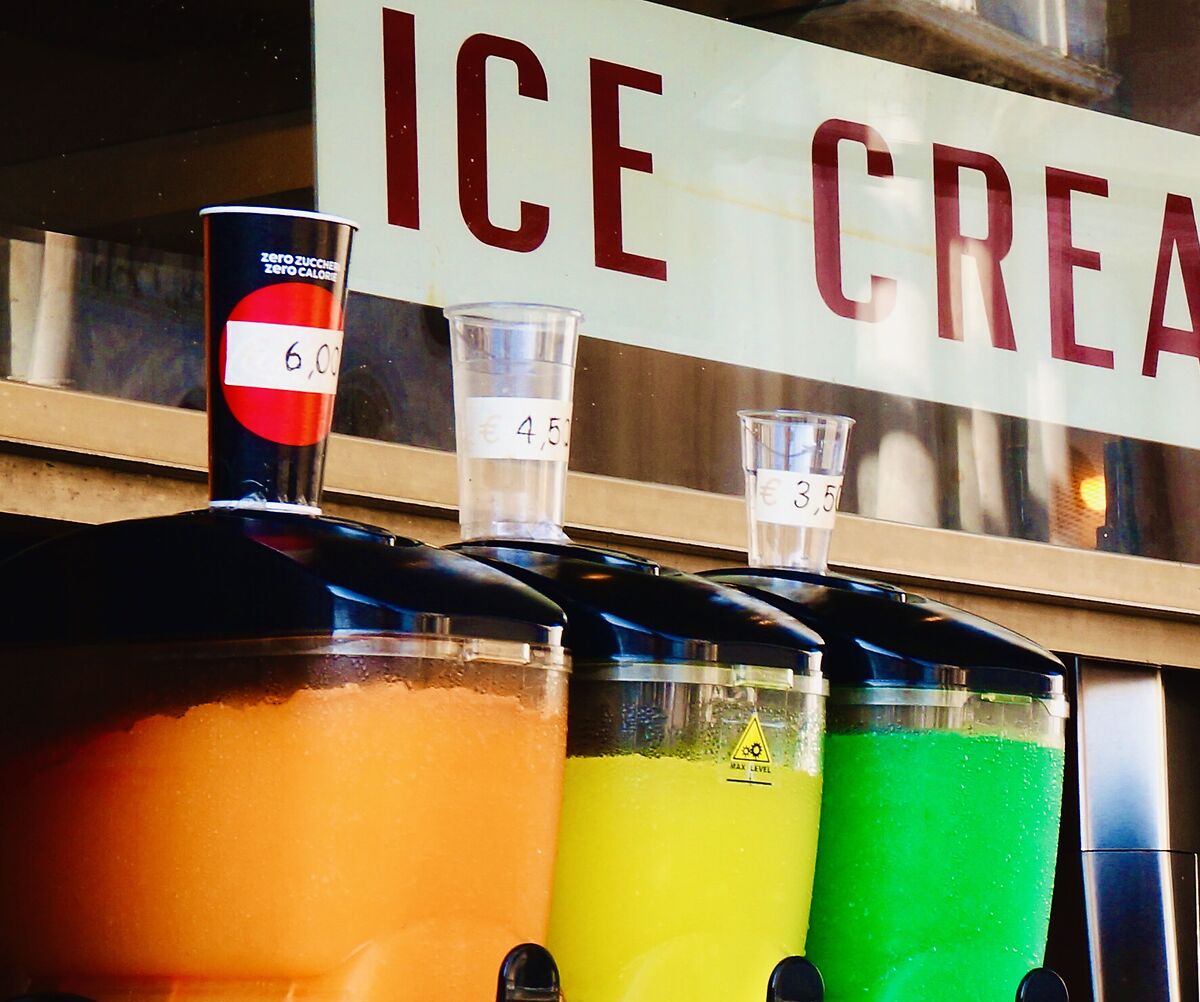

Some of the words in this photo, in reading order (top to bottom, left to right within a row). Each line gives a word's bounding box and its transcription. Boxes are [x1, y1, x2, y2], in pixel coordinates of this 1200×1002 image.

[383, 6, 667, 281] ICE
[260, 252, 294, 265] zero
[264, 263, 297, 276] zero
[730, 762, 746, 770] MAX
[750, 765, 772, 774] LEVEL
